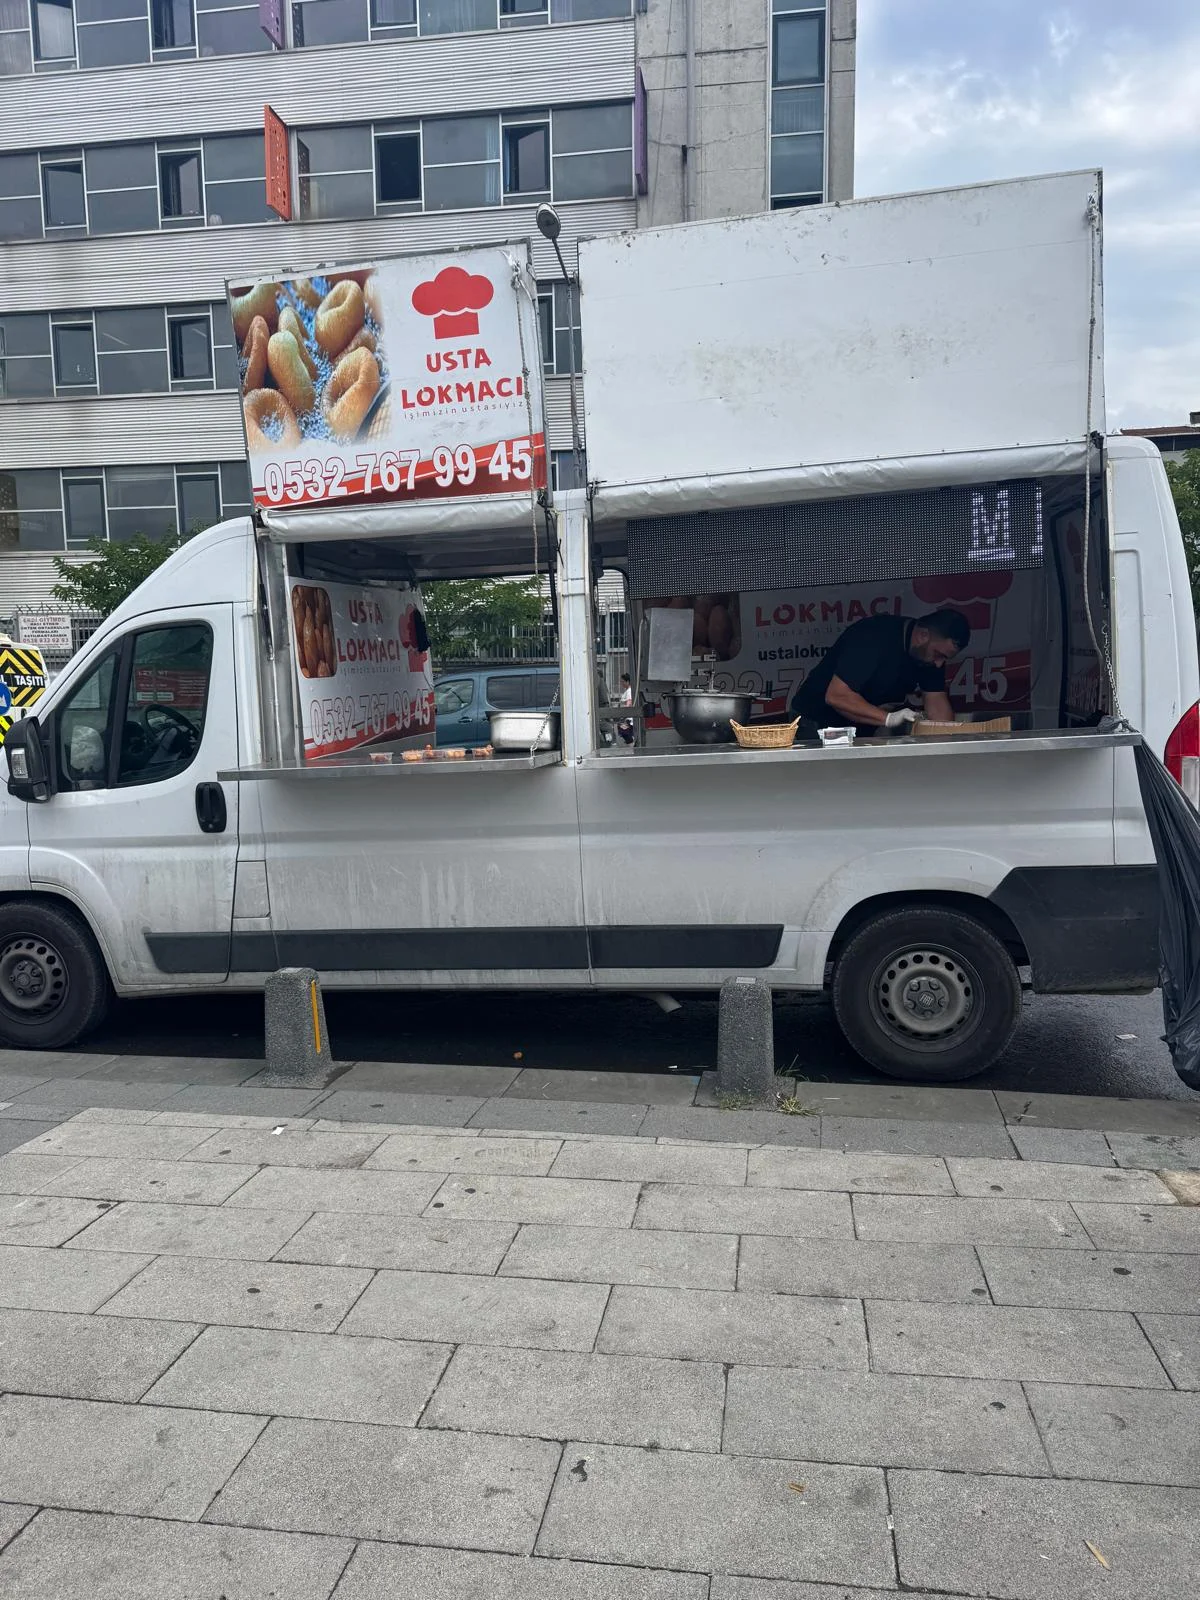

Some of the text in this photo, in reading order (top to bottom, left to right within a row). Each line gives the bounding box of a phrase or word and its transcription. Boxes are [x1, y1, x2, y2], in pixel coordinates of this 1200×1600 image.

[426, 348, 492, 373] USTA
[401, 376, 523, 409] LOKMACI
[264, 440, 532, 502] 0532 767 99 45
[348, 600, 383, 624] USTA
[337, 638, 401, 662] LOKMACI
[949, 656, 1009, 704] 45
[310, 688, 431, 746] 0532 767 99 45
